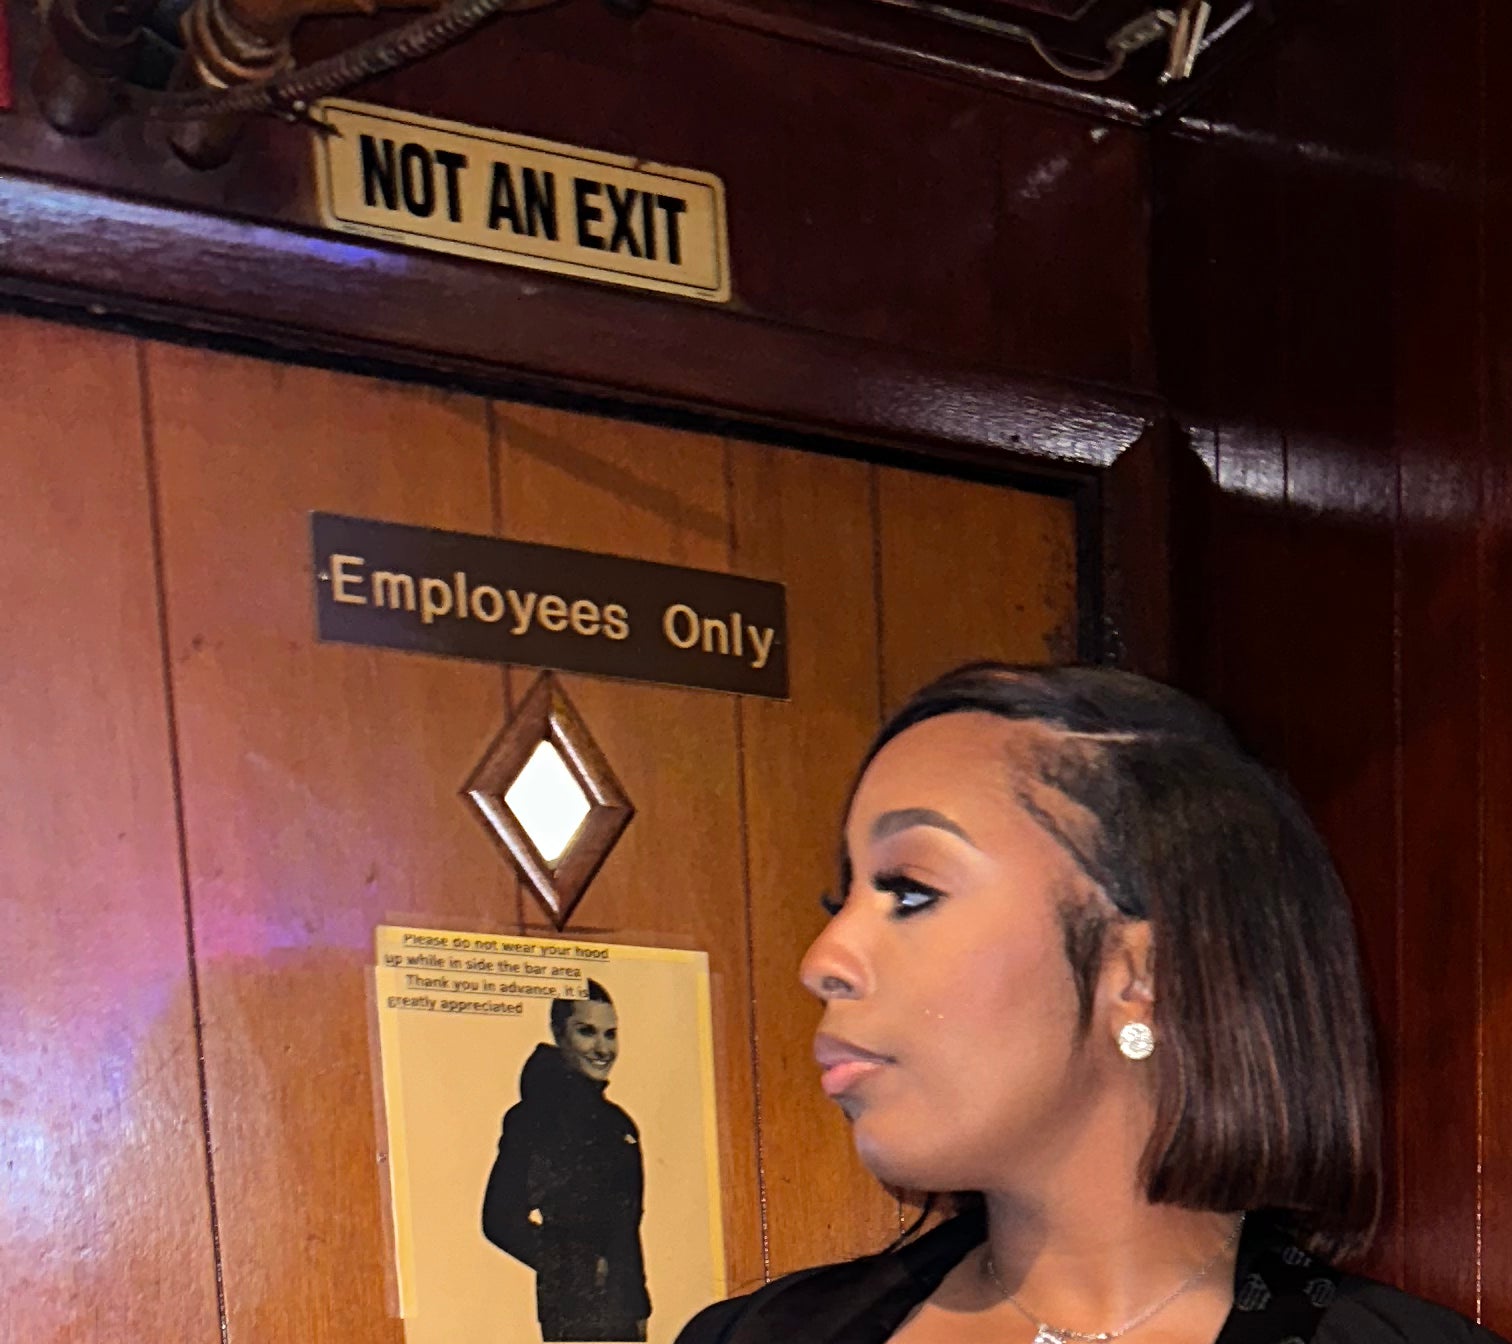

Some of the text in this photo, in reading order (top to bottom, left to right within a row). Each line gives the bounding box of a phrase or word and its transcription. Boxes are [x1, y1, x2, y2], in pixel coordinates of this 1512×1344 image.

[360, 134, 688, 265] NOT AN EXIT
[329, 553, 776, 669] Employees Only
[403, 934, 609, 959] Please do not wear your hood
[384, 954, 581, 977] up while in side the bar area
[406, 974, 448, 988] Thank
[453, 981, 478, 992] you
[483, 979, 496, 991] in
[564, 984, 574, 996] it
[578, 986, 588, 998] is
[387, 995, 523, 1014] greatly appreciated
